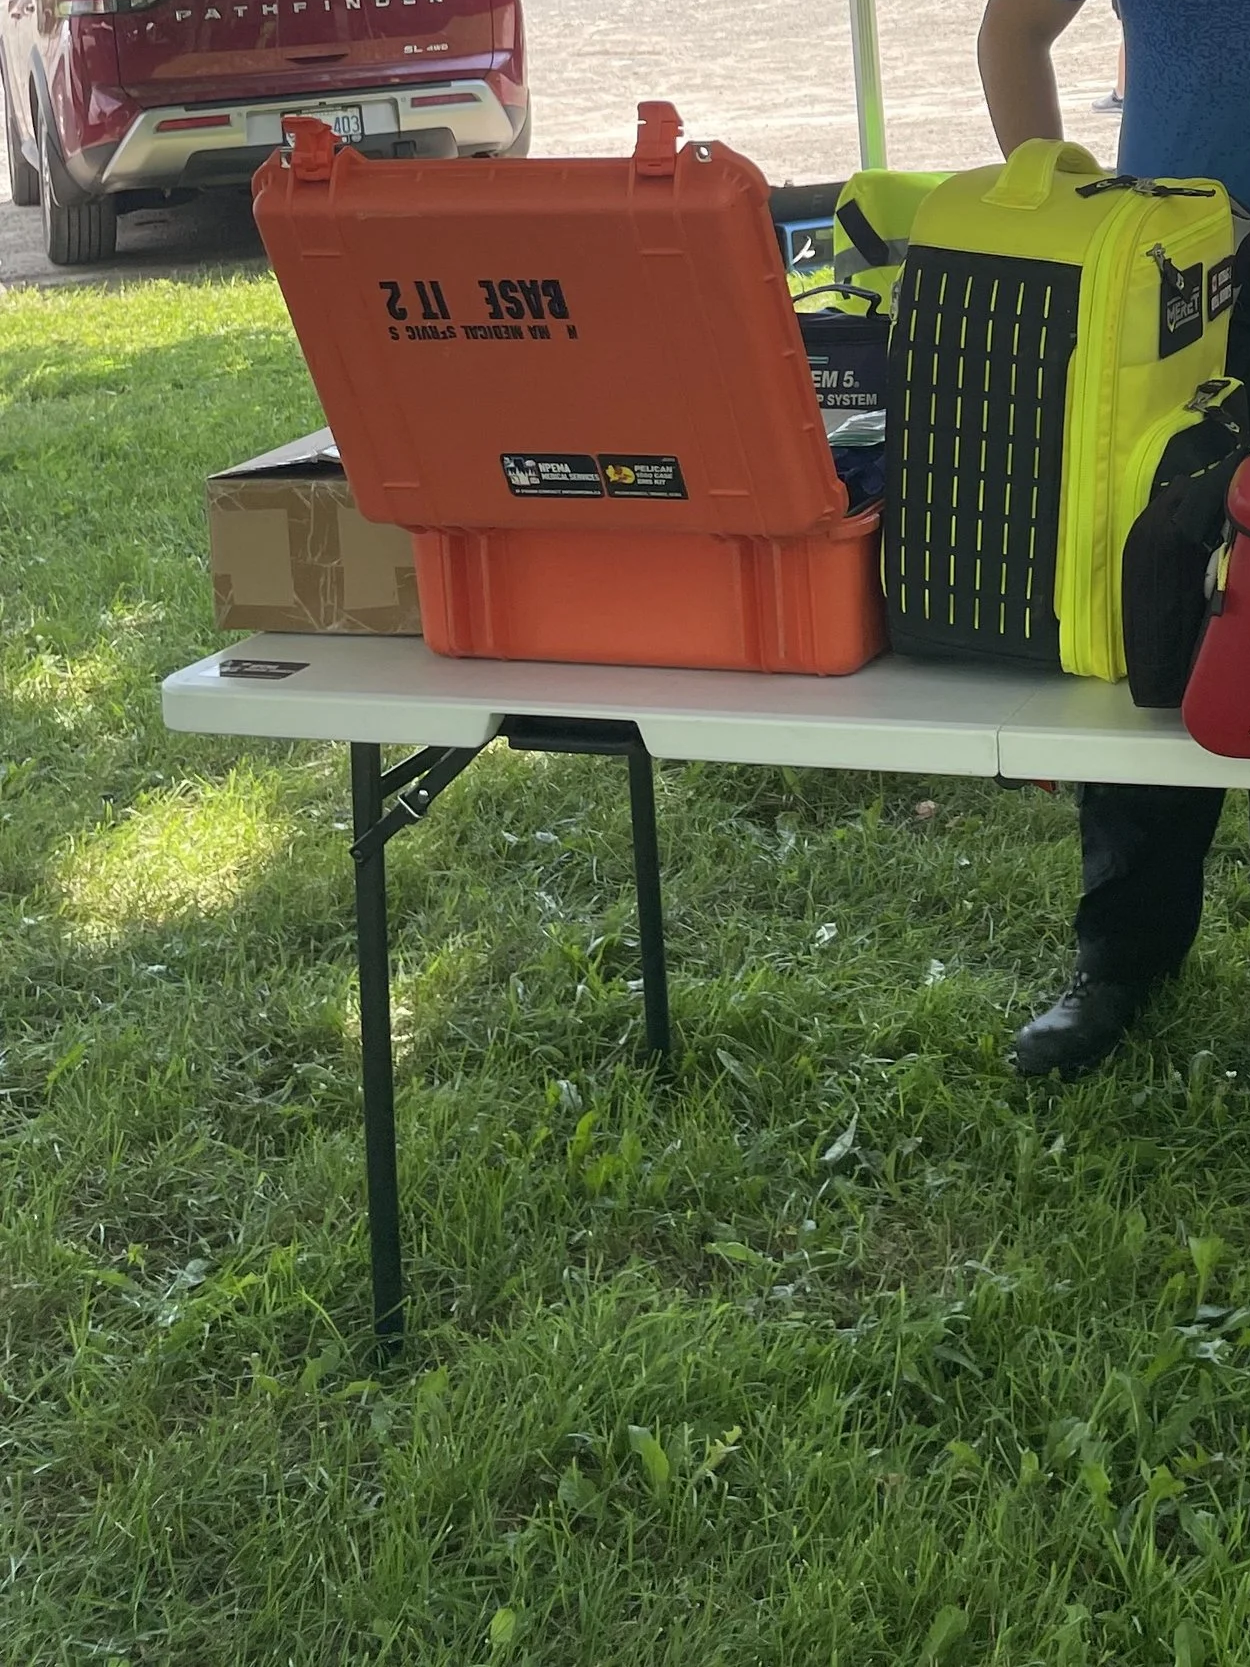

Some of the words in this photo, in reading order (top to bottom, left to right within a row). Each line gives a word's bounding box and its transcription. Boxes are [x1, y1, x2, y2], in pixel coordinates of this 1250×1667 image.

[403, 45, 423, 54] SL
[379, 281, 408, 320] 2
[414, 280, 451, 320] IT
[478, 279, 570, 320] BASE
[388, 325, 458, 341] SERVICS
[464, 324, 525, 340] MEDICAL
[812, 370, 838, 388] EM
[827, 393, 878, 406] SYSTEM
[538, 462, 571, 473] NPEMA
[634, 464, 673, 473] PELICAN
